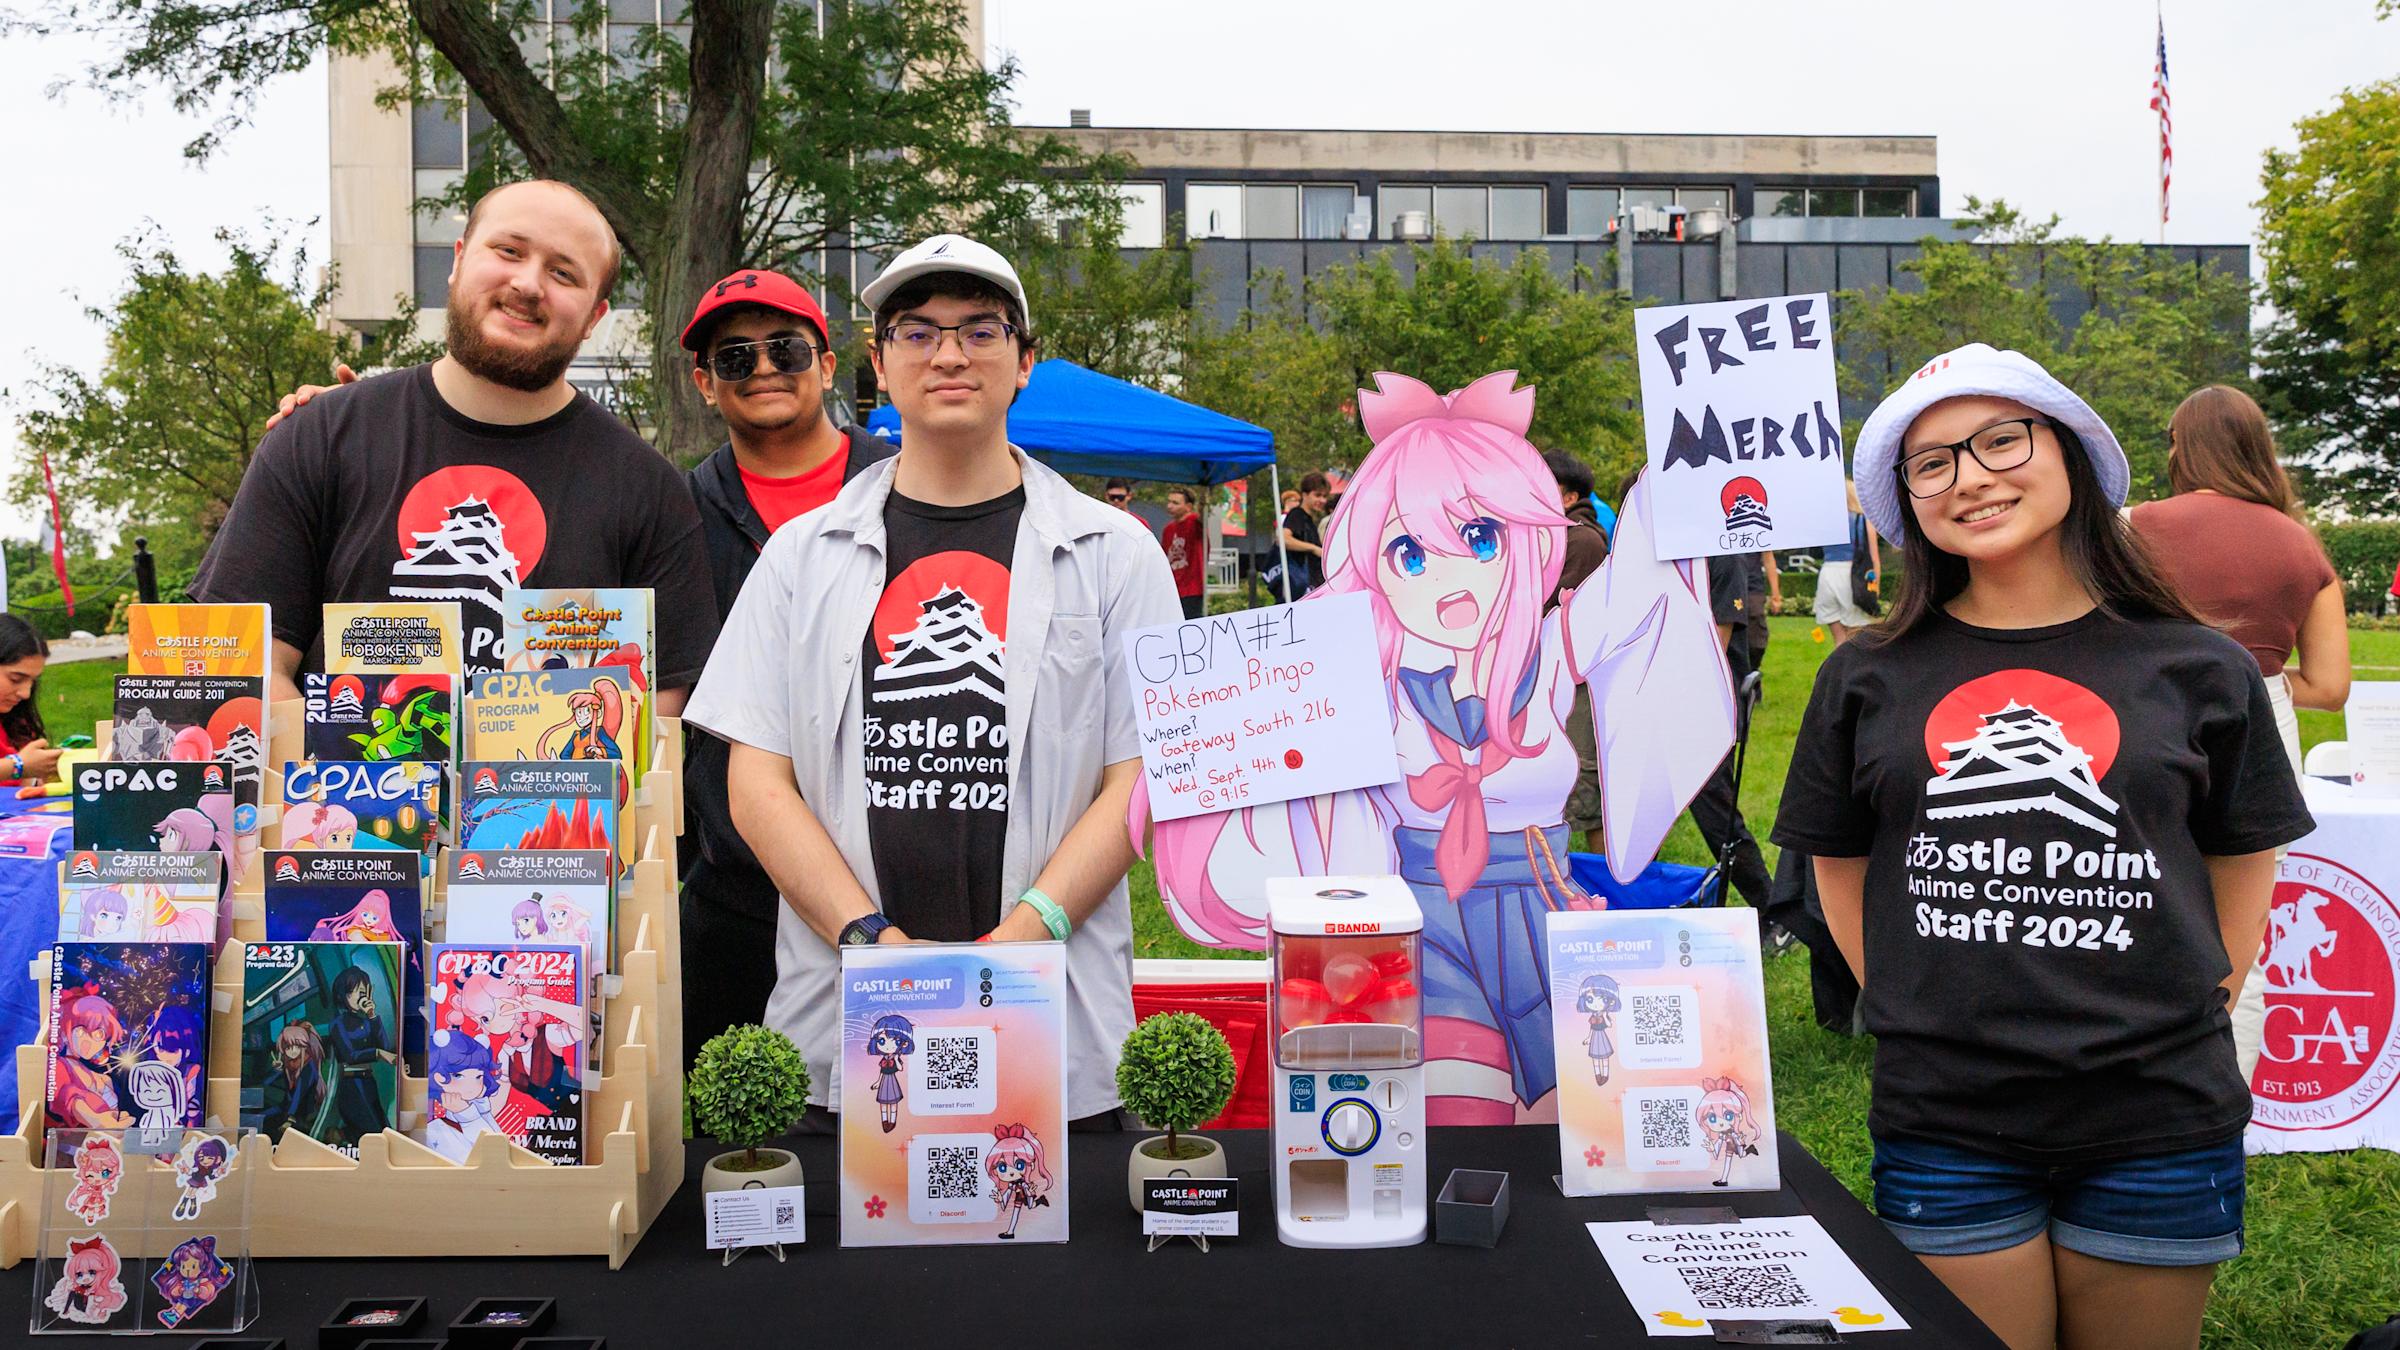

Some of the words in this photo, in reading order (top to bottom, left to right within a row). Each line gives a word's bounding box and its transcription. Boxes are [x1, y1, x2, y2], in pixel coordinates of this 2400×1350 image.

[1654, 300, 1821, 387] FREE
[1719, 531, 1771, 549] CPあC
[578, 608, 622, 620] Point
[394, 618, 427, 628] POINT
[546, 622, 599, 635] Anime
[343, 629, 374, 638] ANIME
[376, 629, 440, 638] CONVENTION
[203, 637, 238, 647] POINT
[524, 637, 619, 650] Convention
[143, 649, 176, 658] ANIME
[180, 649, 249, 658] CONVENTION
[342, 644, 416, 656] HOBOKEN
[424, 644, 442, 656] NJ
[394, 657, 404, 665] 29,
[152, 679, 176, 687] POINT
[482, 673, 555, 699] CPAC
[1144, 683, 1241, 721] Pokémon
[1247, 657, 1314, 692] Bingo
[119, 688, 169, 699] PROGRAM
[173, 689, 202, 699] GUIDE
[205, 690, 225, 699] 2011
[306, 674, 327, 723] 2012
[477, 703, 540, 717] PROGRAM
[478, 720, 516, 733] GUIDE
[1144, 715, 1197, 743] Where?
[1161, 731, 1235, 758] Gateway
[1243, 709, 1294, 737] South
[1303, 697, 1336, 723] 216
[1150, 752, 1198, 780] When?
[1252, 757, 1277, 774] 4th
[79, 769, 178, 791] CPAC
[286, 764, 407, 801] CPAC
[555, 772, 589, 783] POINT
[410, 784, 433, 800] 15
[500, 783, 533, 793] ANIME
[536, 783, 601, 793] CONVENTION
[1198, 789, 1215, 808] @
[1220, 782, 1250, 803] 9:15
[160, 856, 195, 867] POINT
[356, 860, 392, 871] POINT
[547, 857, 584, 868] POINT
[2045, 842, 2161, 880] Point
[100, 867, 135, 877] ANIME
[138, 867, 207, 877] CONVENTION
[302, 871, 335, 881] ANIME
[338, 871, 406, 881] CONVENTION
[487, 868, 522, 878] ANIME
[526, 868, 597, 878] CONVENTION
[2297, 864, 2322, 880] OF
[1908, 873, 1975, 900] Anime
[1983, 879, 2153, 909] Convention
[1338, 923, 1380, 933] BANDAI
[1915, 902, 2014, 943] Staff
[2021, 914, 2134, 952] 2024
[1559, 941, 1603, 953] CASTLE
[1616, 940, 1652, 951] POINT
[514, 953, 575, 976] 2024
[1597, 954, 1639, 962] CONVENTION
[246, 961, 276, 969] Program
[508, 975, 545, 987] Program
[547, 976, 574, 986] Guide
[853, 980, 899, 993] CASTLE
[913, 978, 952, 992] POINT
[53, 984, 63, 1010] Point
[868, 993, 891, 1001] ANIME
[892, 992, 937, 1001] CONVENTION
[51, 1011, 61, 1043] Anime
[2349, 1023, 2400, 1110] ASSOCIATI
[47, 1045, 59, 1102] Convention
[1294, 1088, 1311, 1096] COIN
[2262, 1079, 2289, 1096] EST.
[2292, 1079, 2322, 1096] 1913
[525, 1116, 577, 1131] BRAND
[535, 1134, 577, 1150] Merch
[1152, 1189, 1188, 1199] CASTLE
[1198, 1189, 1228, 1198] POINT
[1627, 1231, 1712, 1242] Castle
[1719, 1228, 1797, 1239] Point
[1674, 1240, 1762, 1252] Anime
[1642, 1250, 1808, 1264] Convention
